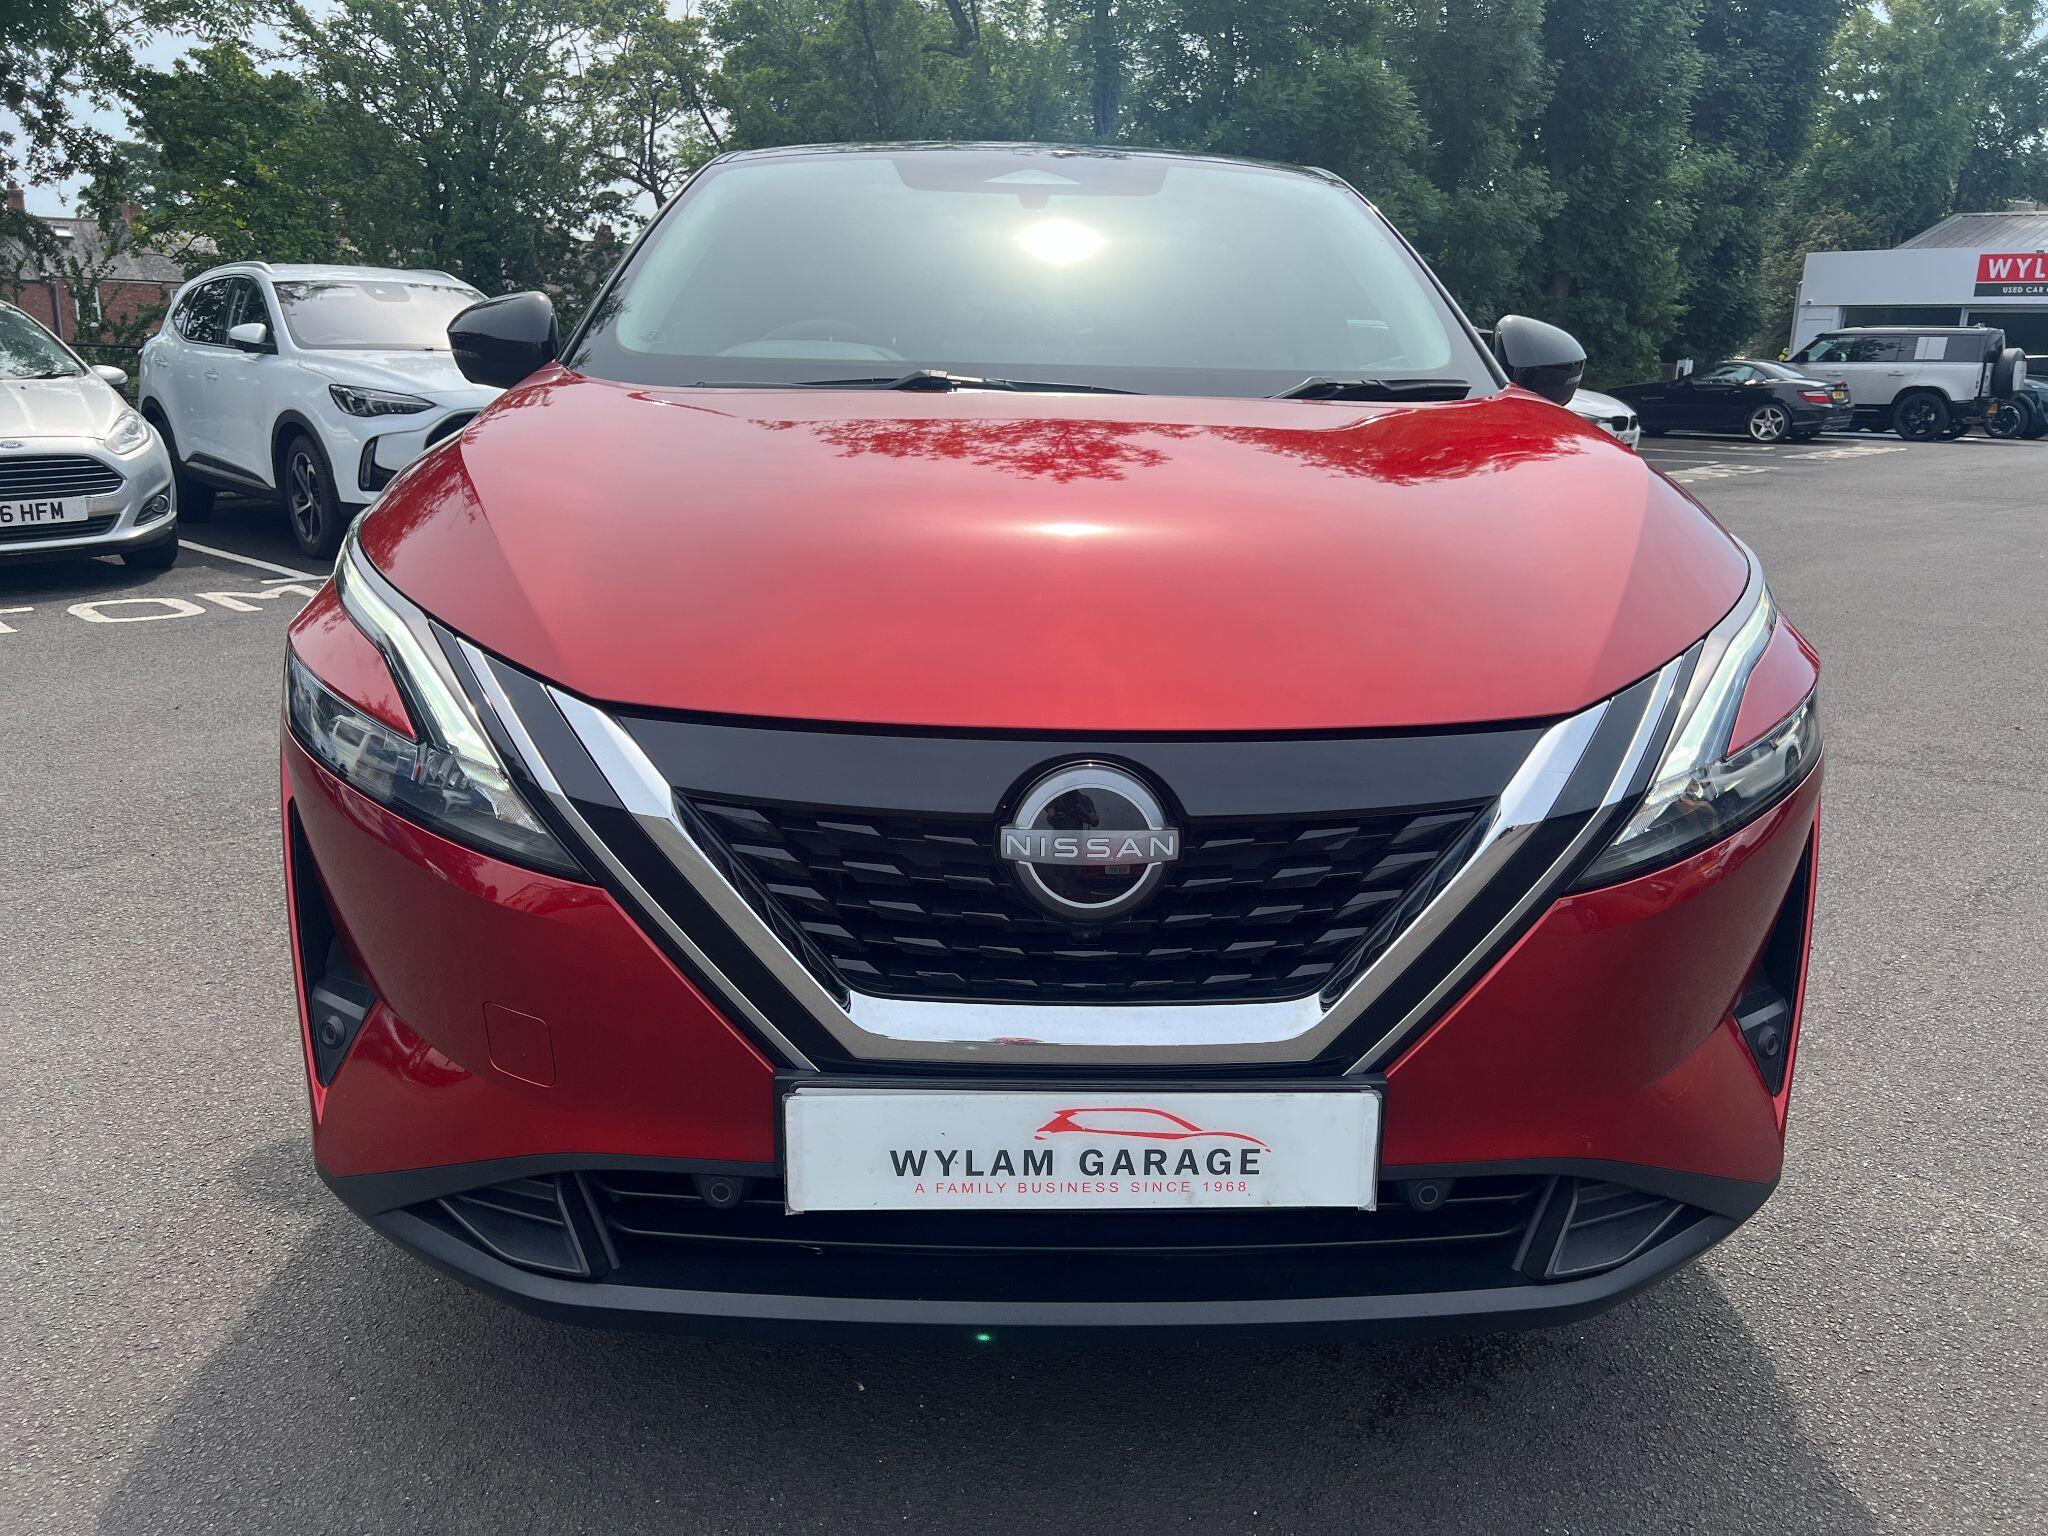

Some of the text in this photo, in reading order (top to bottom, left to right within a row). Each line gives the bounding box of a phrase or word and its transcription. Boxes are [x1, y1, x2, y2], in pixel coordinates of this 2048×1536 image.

[1989, 258, 2046, 279] WYL
[20, 501, 64, 522] HFM
[1006, 834, 1174, 858] NISSAN
[890, 1148, 1260, 1177] WYLAM GARAGE
[914, 1181, 1247, 1194] A FAMILY BUSINESS SINCE 1968
